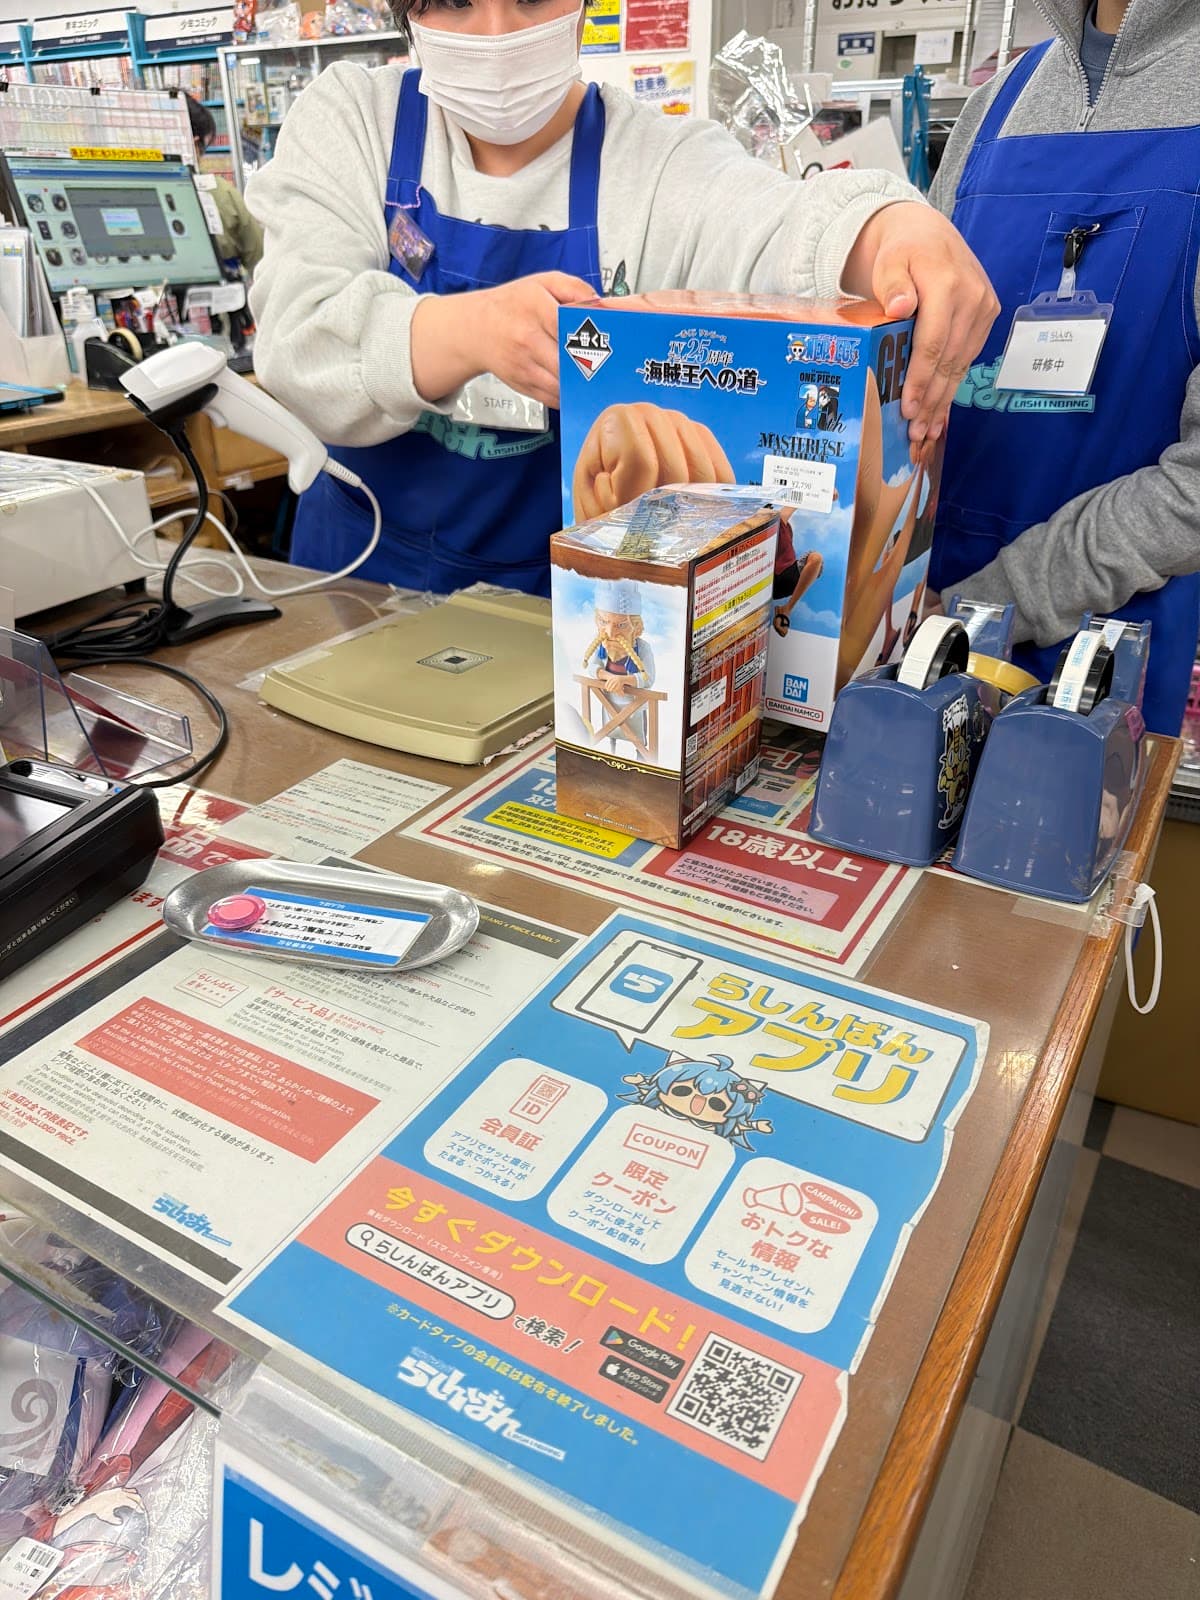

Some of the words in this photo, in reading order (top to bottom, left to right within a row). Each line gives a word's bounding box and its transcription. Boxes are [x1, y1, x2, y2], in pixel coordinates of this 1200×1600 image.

[567, 332, 611, 350] 一番くじ
[1032, 357, 1065, 372] 研修中
[484, 397, 513, 409] STAFF
[1013, 398, 1090, 410] LASHINBANG
[784, 687, 803, 699] DAI
[785, 677, 807, 691] BAN
[767, 700, 795, 714] BANDAI
[794, 705, 821, 720] NAMCO
[709, 757, 865, 814] 18歳以上
[261, 985, 340, 1021] 『サービス品』
[702, 970, 939, 1069] らしんばん
[668, 995, 919, 1118] アプリ
[518, 1099, 545, 1117] ID
[476, 1115, 544, 1152] 会員証
[629, 1131, 702, 1161] COUPON
[444, 1140, 528, 1181] スマホでポイントが
[620, 1160, 671, 1190] 限定
[579, 1189, 664, 1231] ダウンロードして
[589, 1169, 679, 1218] クーポン
[803, 1183, 860, 1218] CAMPAIGN!
[582, 1203, 648, 1236] スグに使える
[739, 1210, 834, 1261] おトクな
[807, 1214, 843, 1232] SALE!
[712, 1248, 817, 1298] セールやプレゼント
[747, 1238, 802, 1274] 情報
[370, 1238, 504, 1313] らしんばんアプリ
[707, 1259, 811, 1310] キャンペーン情報を
[623, 1336, 660, 1361] Google
[654, 1351, 681, 1372] Play
[383, 1300, 641, 1447] ※カードタイプの会員証は配布を終了しました。
[619, 1366, 642, 1384] App
[637, 1375, 665, 1394] Store
